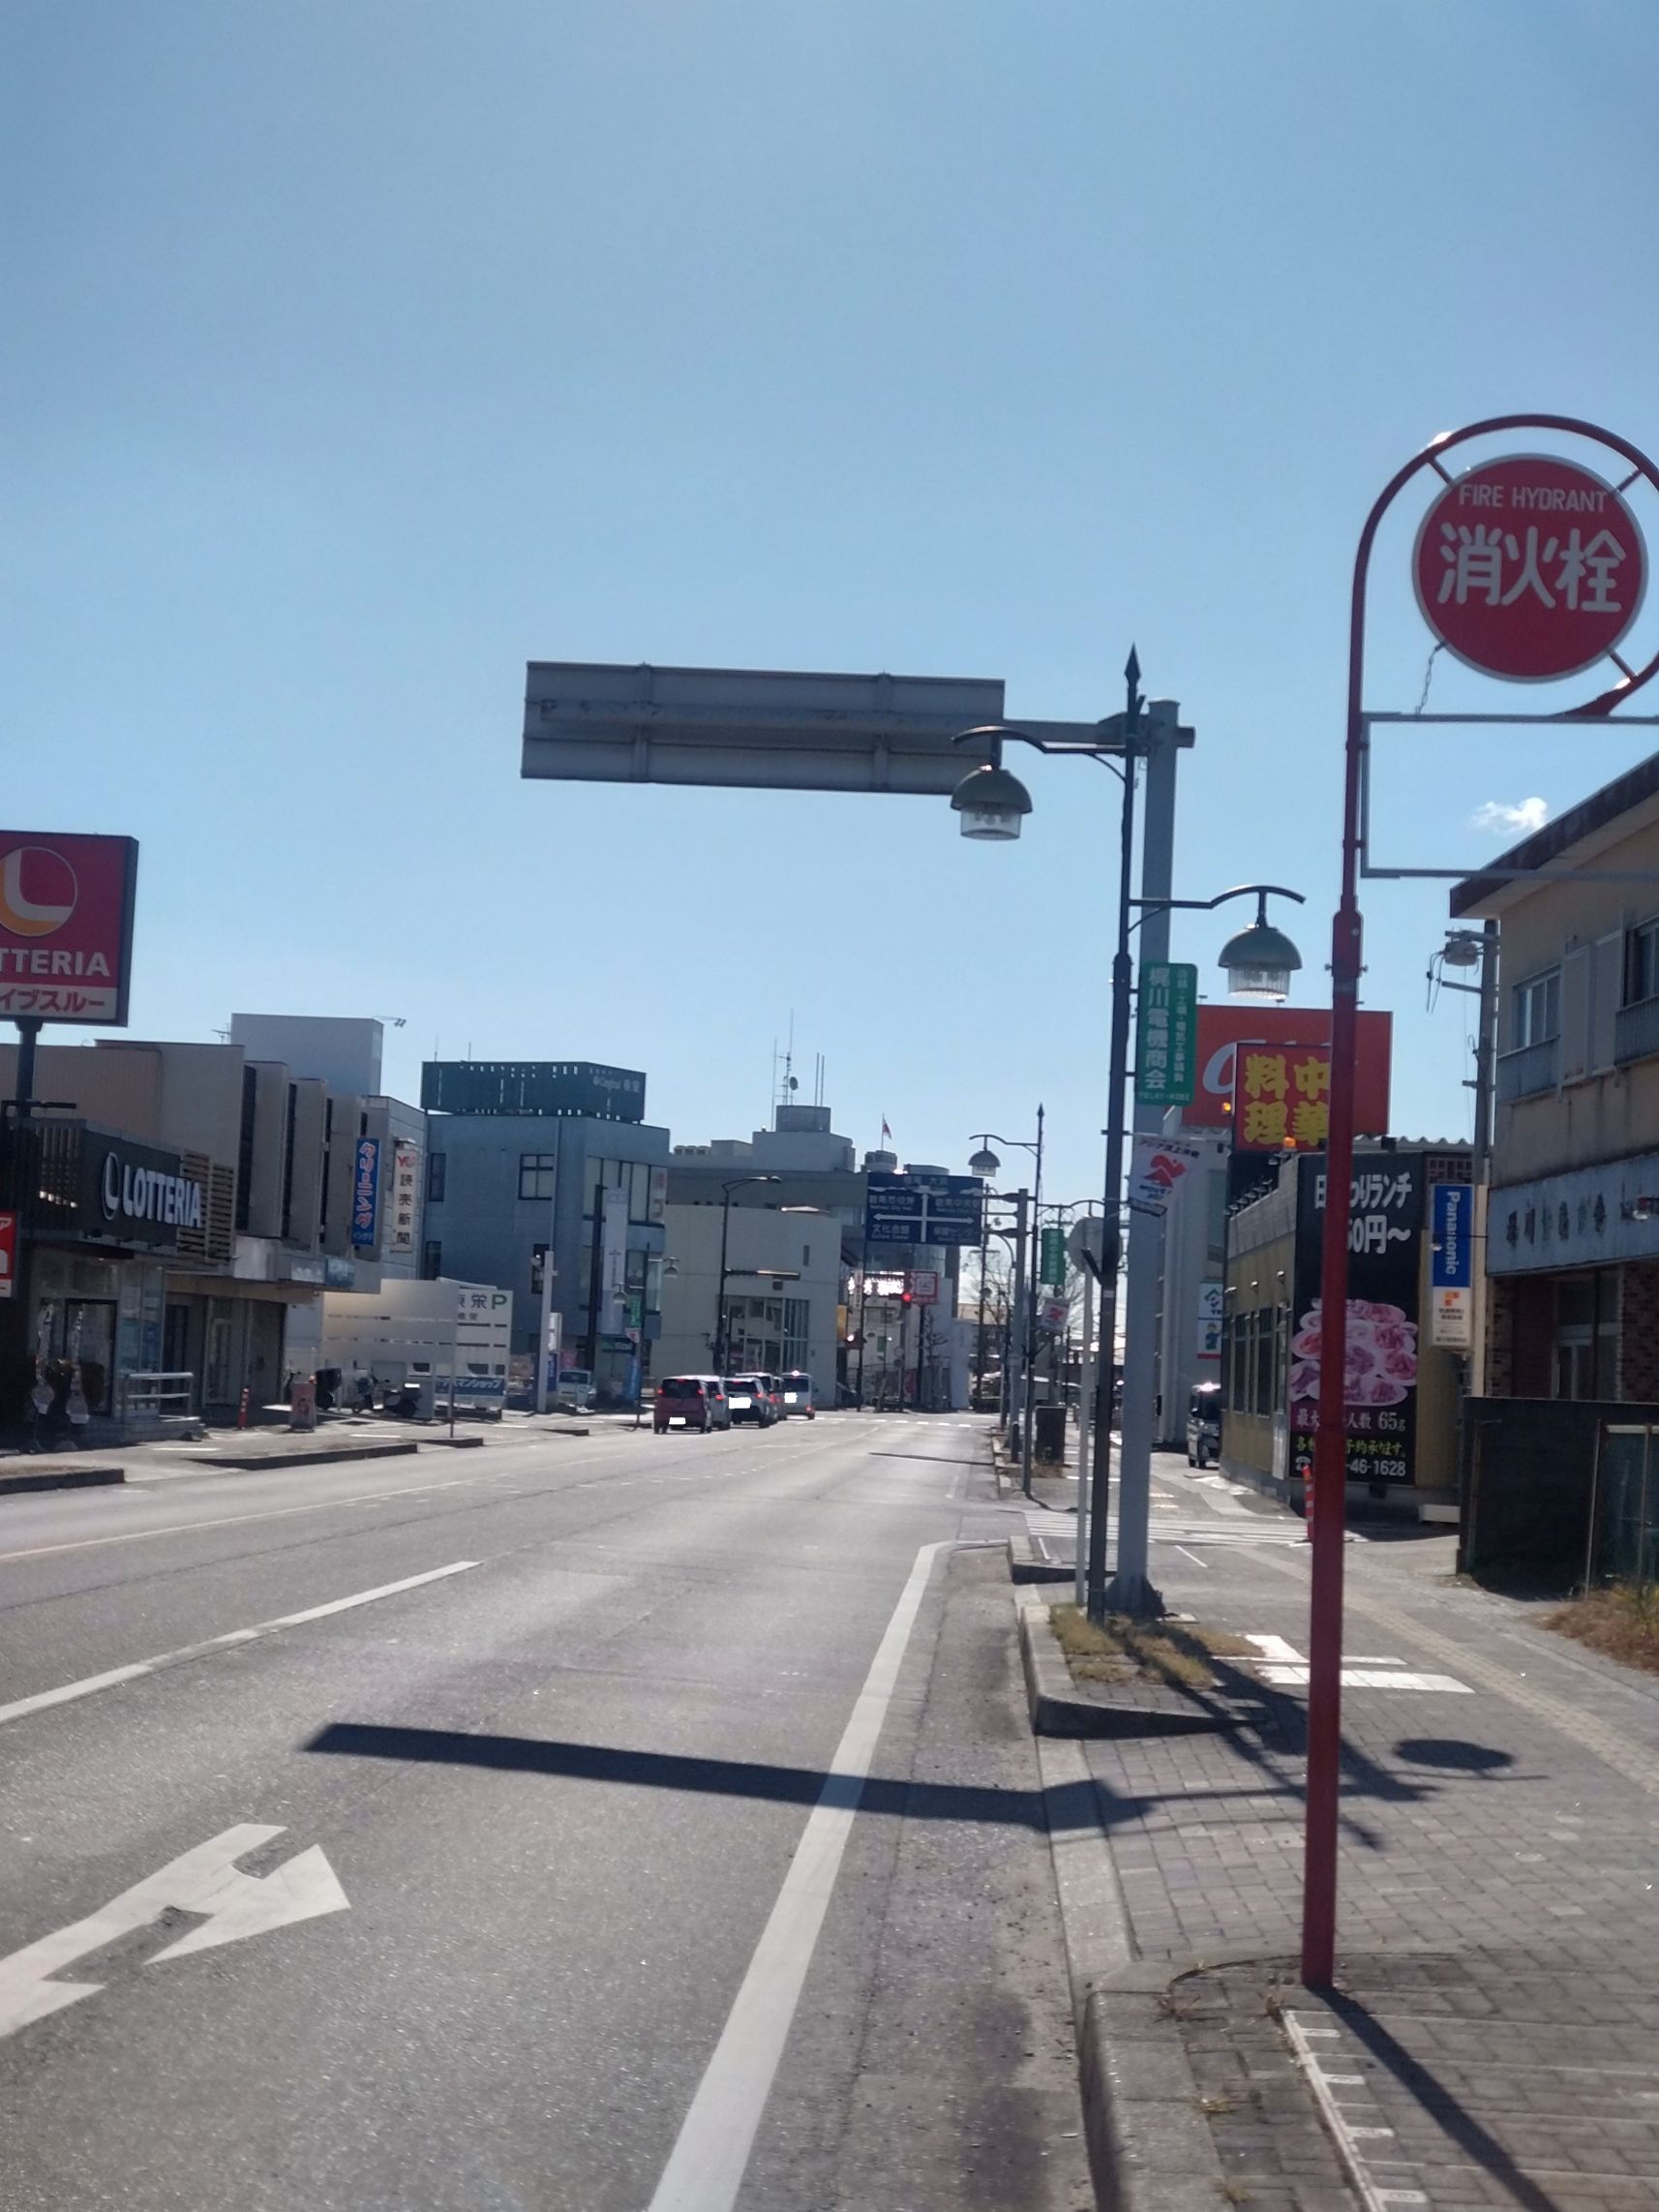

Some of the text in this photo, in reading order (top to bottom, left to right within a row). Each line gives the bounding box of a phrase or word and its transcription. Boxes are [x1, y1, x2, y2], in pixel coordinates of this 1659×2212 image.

[1458, 484, 1608, 513] FIRE HYDRANT
[1437, 522, 1627, 613] 消火栓
[123, 1164, 202, 1228] LOTTERIA
[396, 1173, 413, 1245] 読売新聞
[492, 1294, 507, 1310] P
[1297, 1408, 1372, 1430] 最大人数
